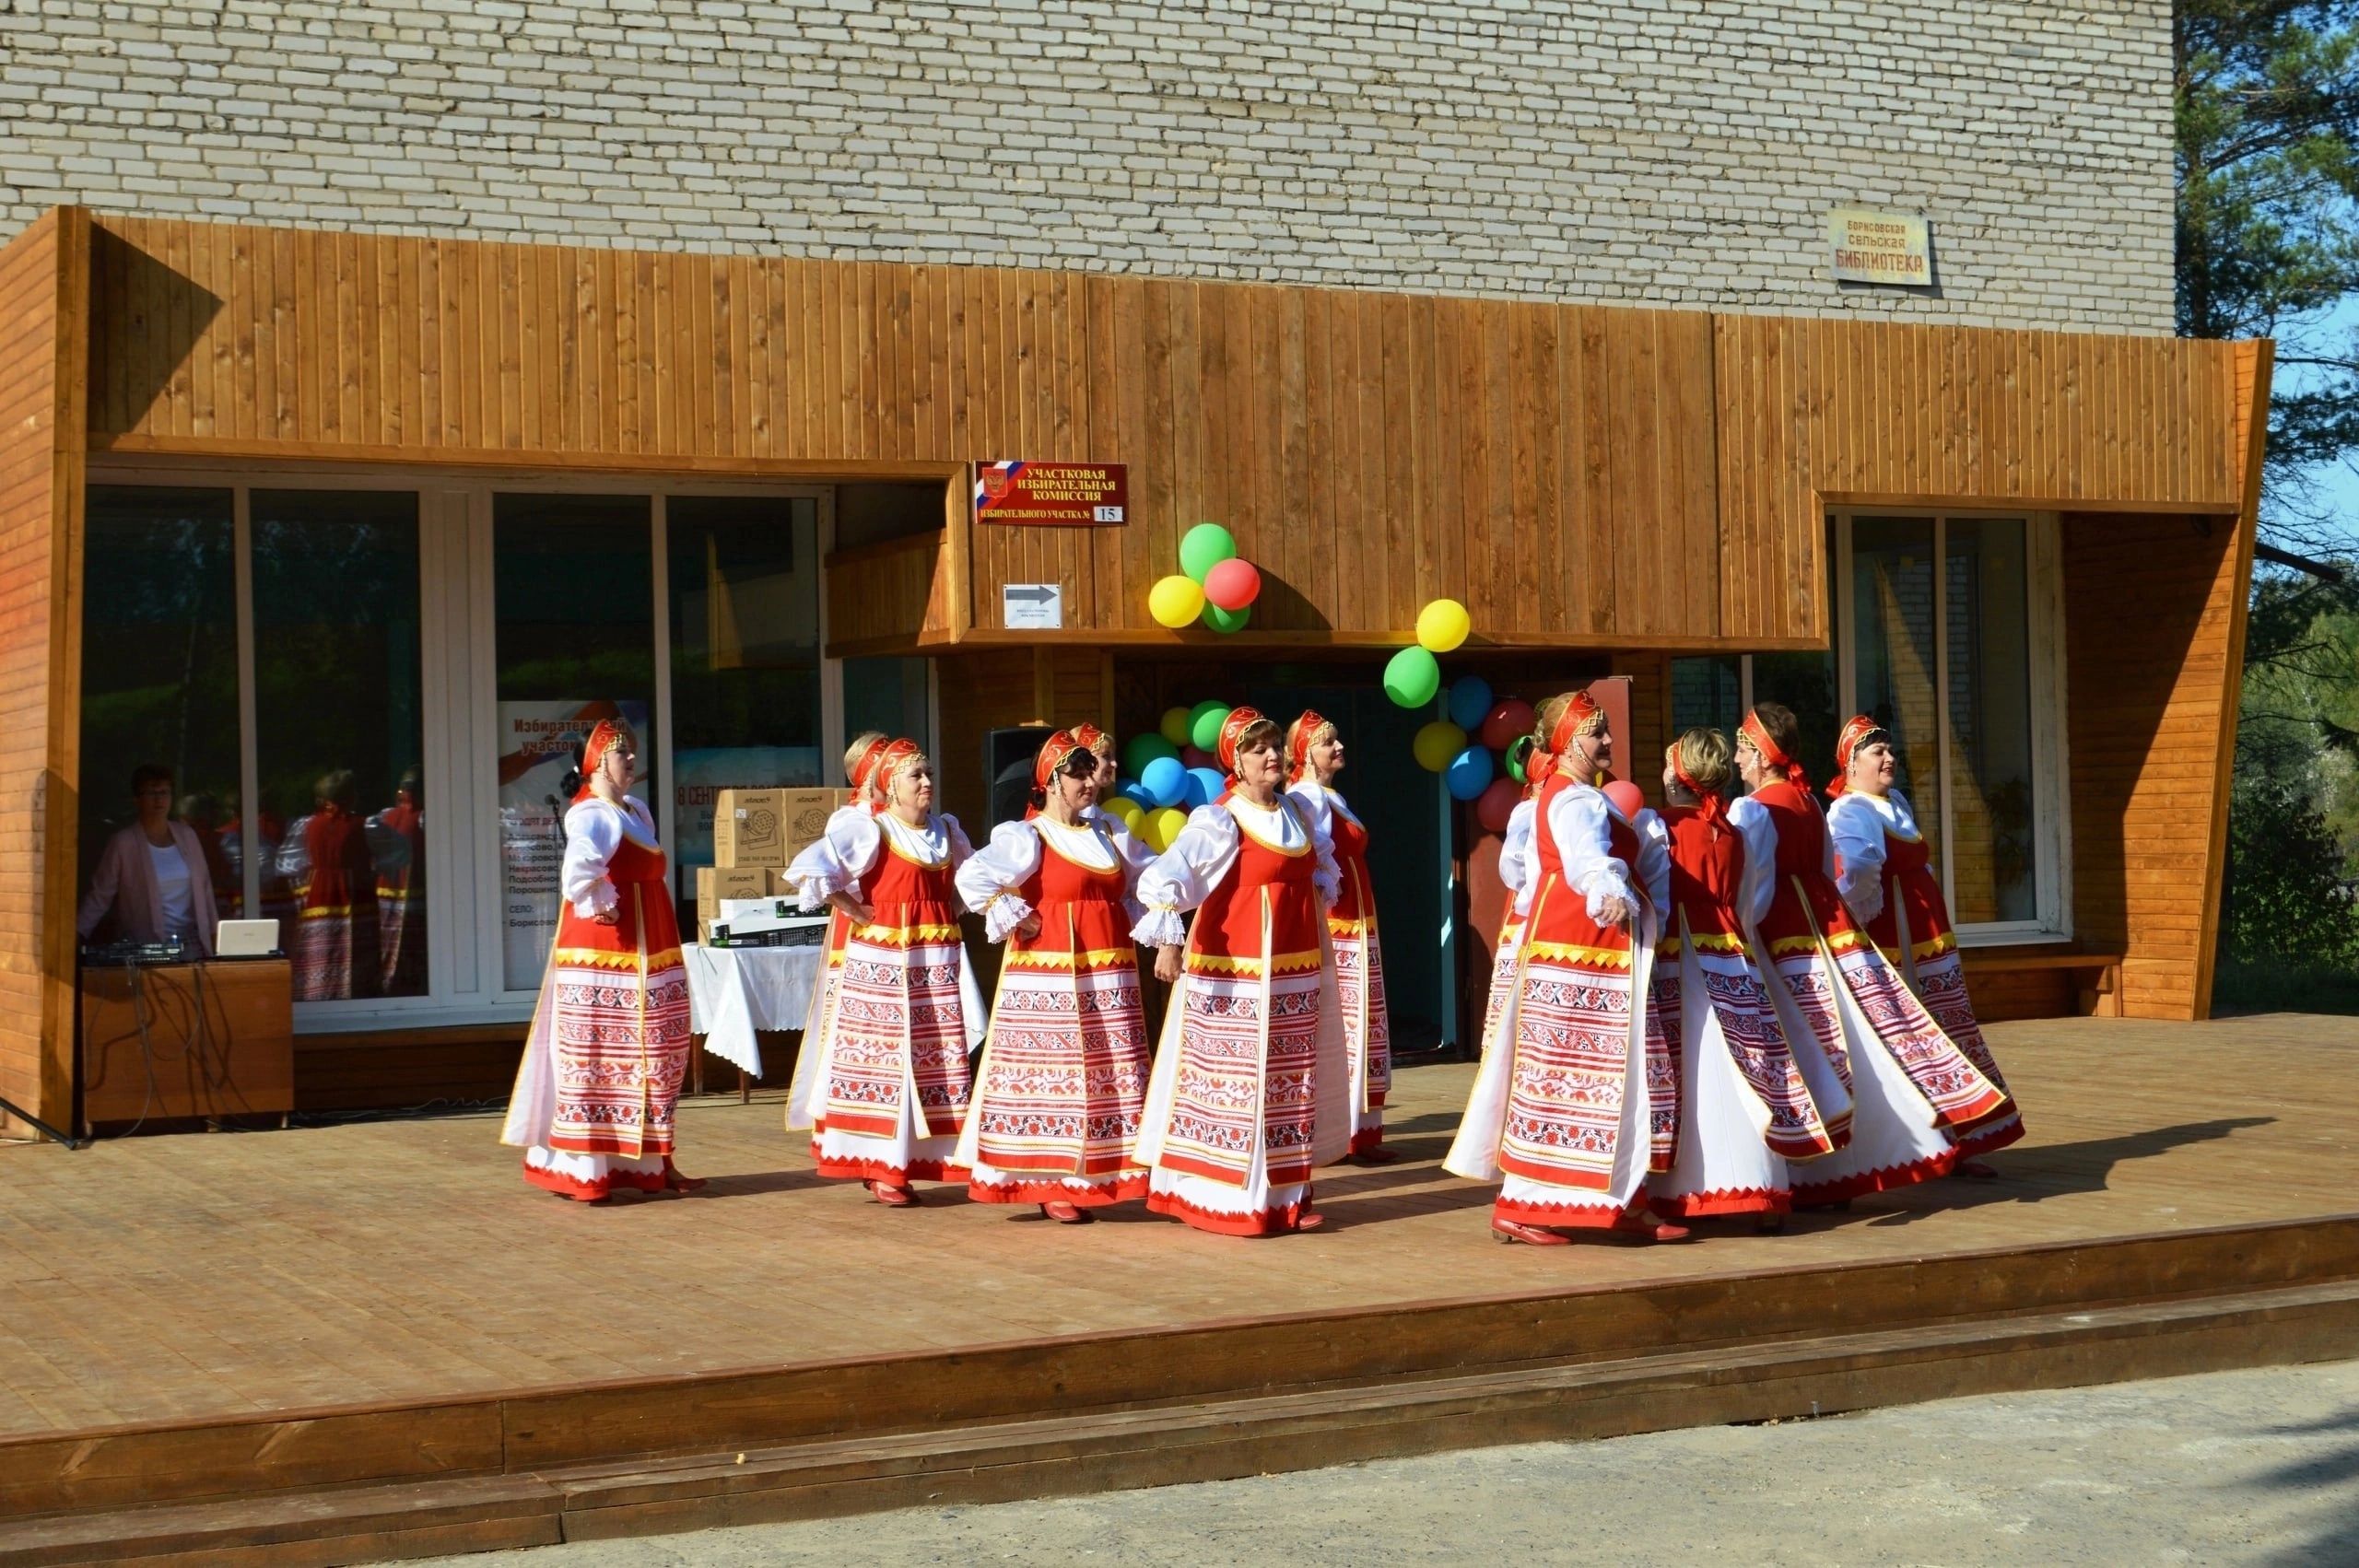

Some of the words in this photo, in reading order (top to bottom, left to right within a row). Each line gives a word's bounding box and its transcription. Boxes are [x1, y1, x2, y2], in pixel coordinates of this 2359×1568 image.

[1836, 249, 1923, 272] БИБЛИОТЕКА
[1027, 468, 1106, 480] УЧАСТКОВАЯ
[1016, 479, 1116, 491] ИЗБИРАТЕЛЬНАЯ
[1032, 490, 1102, 501] КОМИССИЯ
[980, 509, 1047, 519] ИЗБИРАТЕЛЬНОГО
[1047, 509, 1082, 520] УЧАСТКА
[1100, 508, 1116, 521] 15
